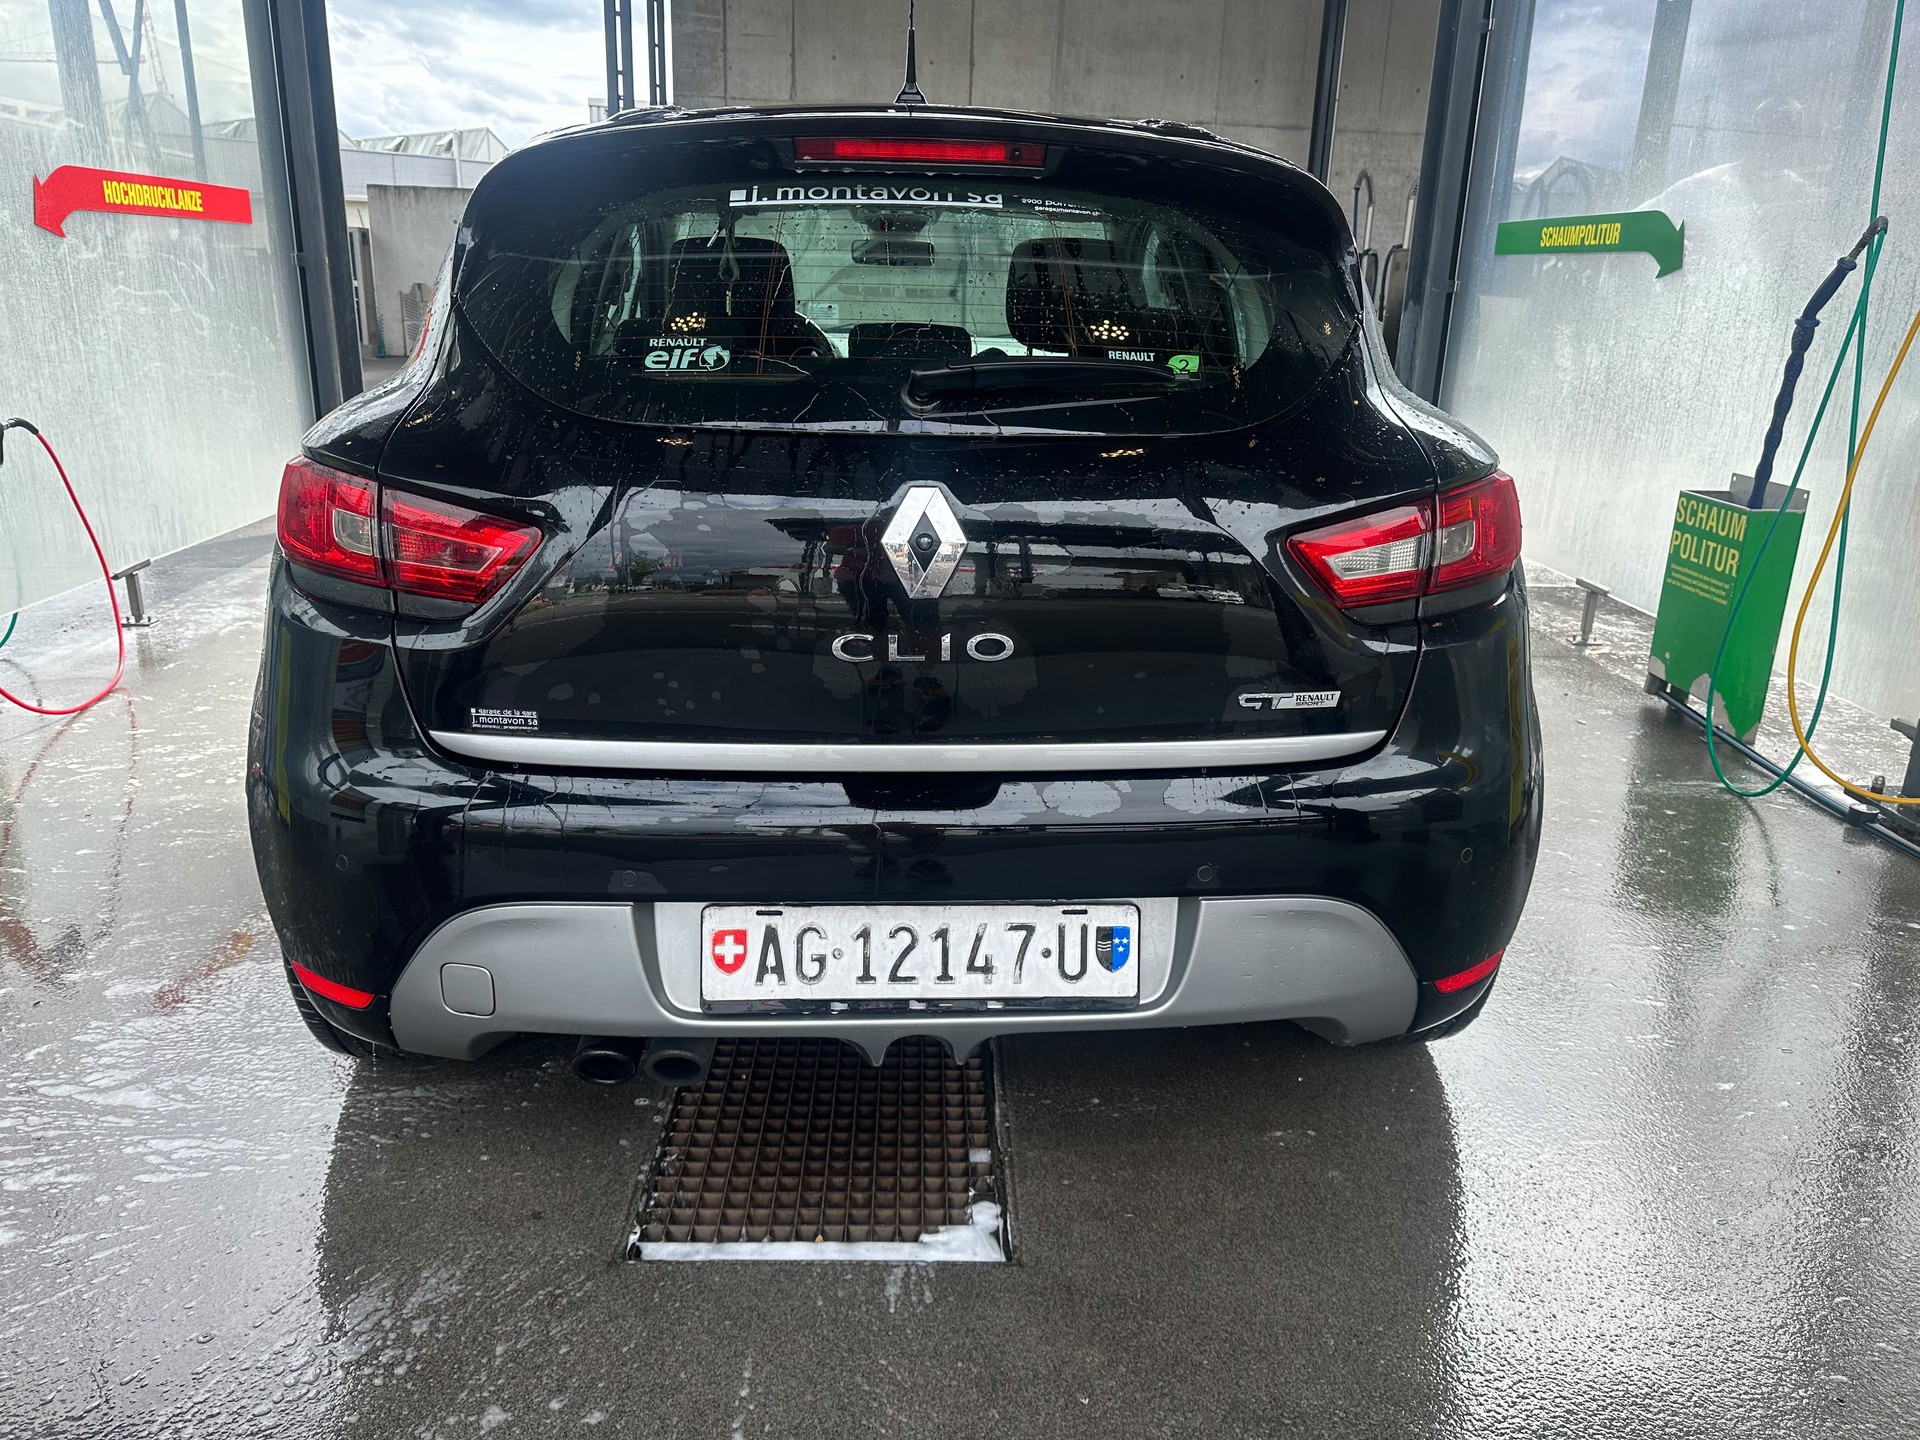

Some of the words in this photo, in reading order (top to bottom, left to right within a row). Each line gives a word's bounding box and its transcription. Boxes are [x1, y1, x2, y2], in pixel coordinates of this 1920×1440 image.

[103, 180, 203, 212] HOCHDRUCKLANZE
[1540, 222, 1621, 247] SCHAUMPOLITUR
[649, 338, 707, 347] RENAULT
[644, 348, 699, 369] elf
[1108, 350, 1155, 362] RENAULT
[1677, 497, 1747, 541] SCHAUM
[1670, 531, 1737, 577] POLITUR
[831, 632, 1015, 663] CLIO
[1238, 692, 1293, 709] GT
[1295, 693, 1336, 702] RENAULT
[479, 717, 524, 725] montavon
[502, 708, 512, 716] de
